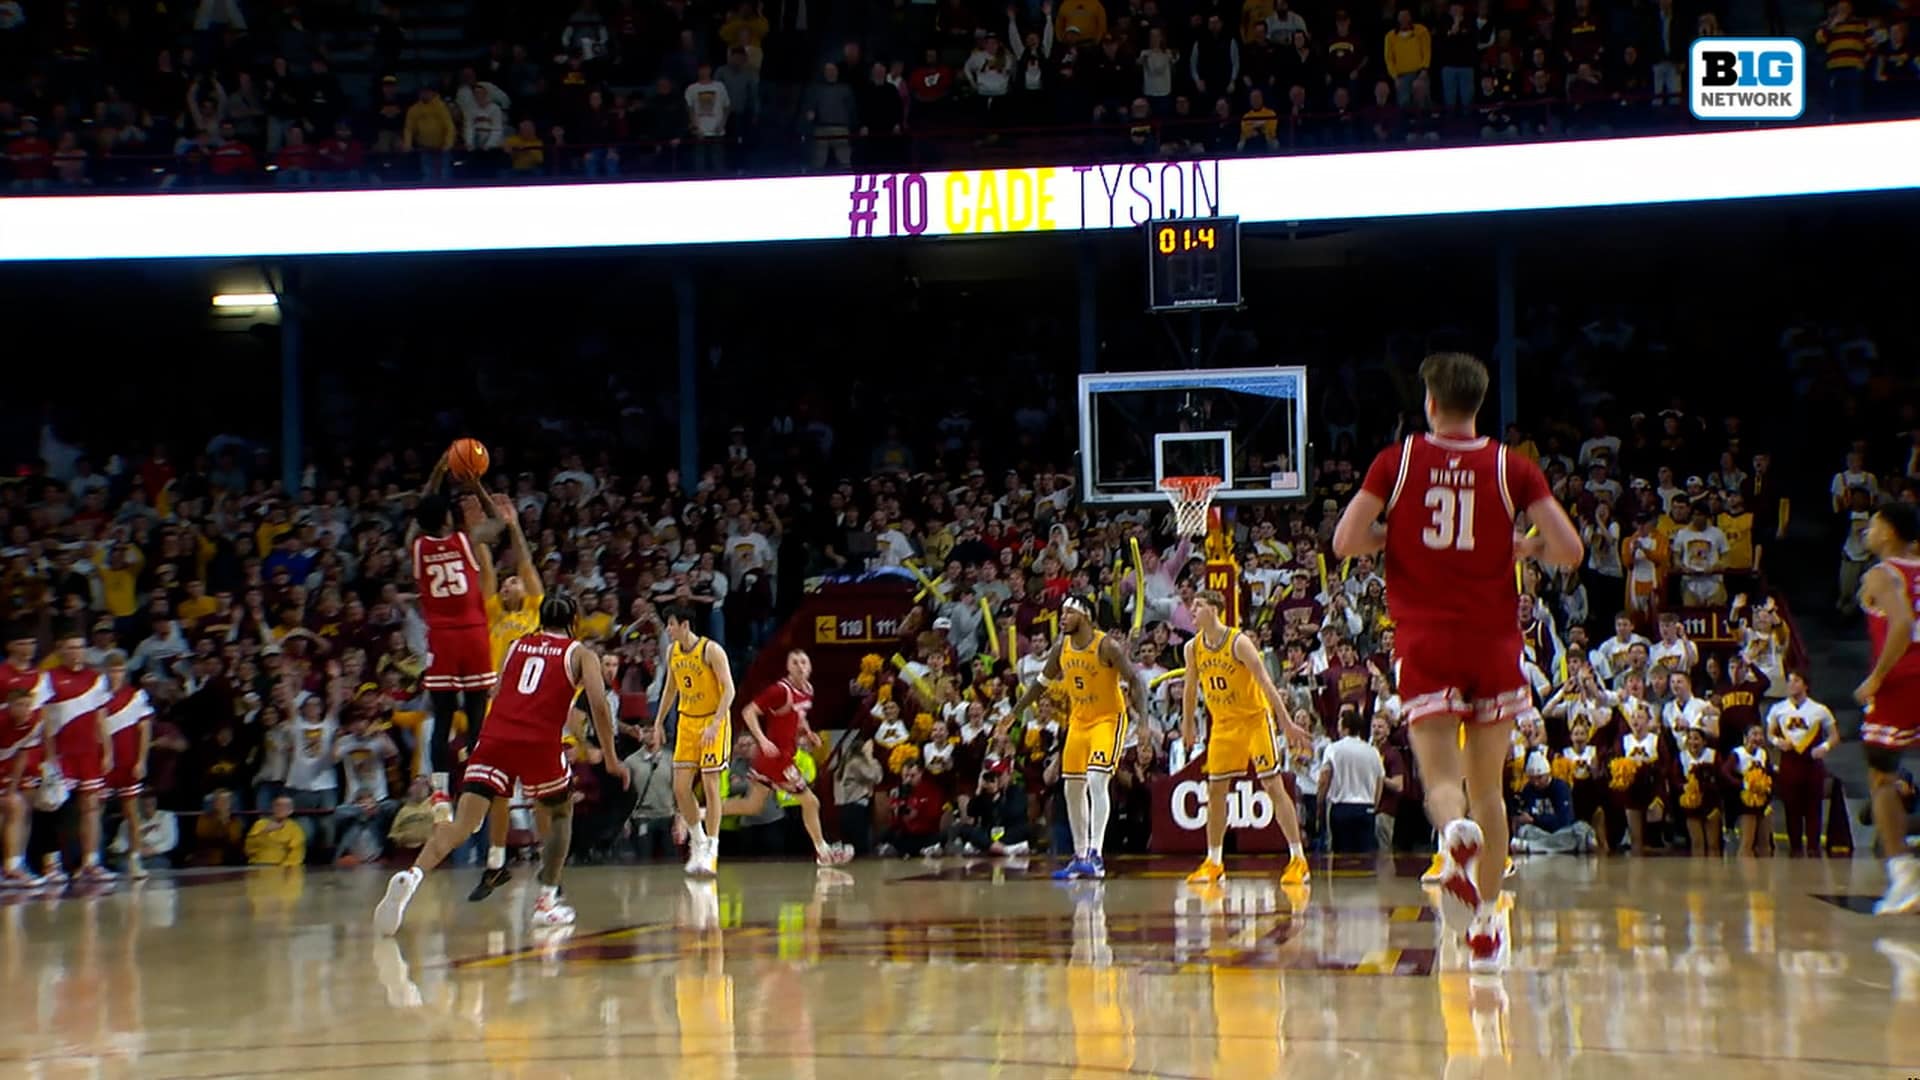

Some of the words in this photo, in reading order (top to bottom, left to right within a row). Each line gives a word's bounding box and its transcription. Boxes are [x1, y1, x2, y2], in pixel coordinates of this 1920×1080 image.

[849, 173, 927, 238] #10
[945, 168, 1056, 234] CADE
[1073, 161, 1219, 231] TYSON
[1159, 228, 1215, 253] 01.4
[1423, 486, 1475, 551] 31
[426, 560, 468, 598] 25
[1209, 572, 1228, 589] M
[517, 656, 545, 694] 0
[684, 676, 692, 688] 3
[1074, 676, 1084, 689] 5
[1209, 676, 1227, 690] 10
